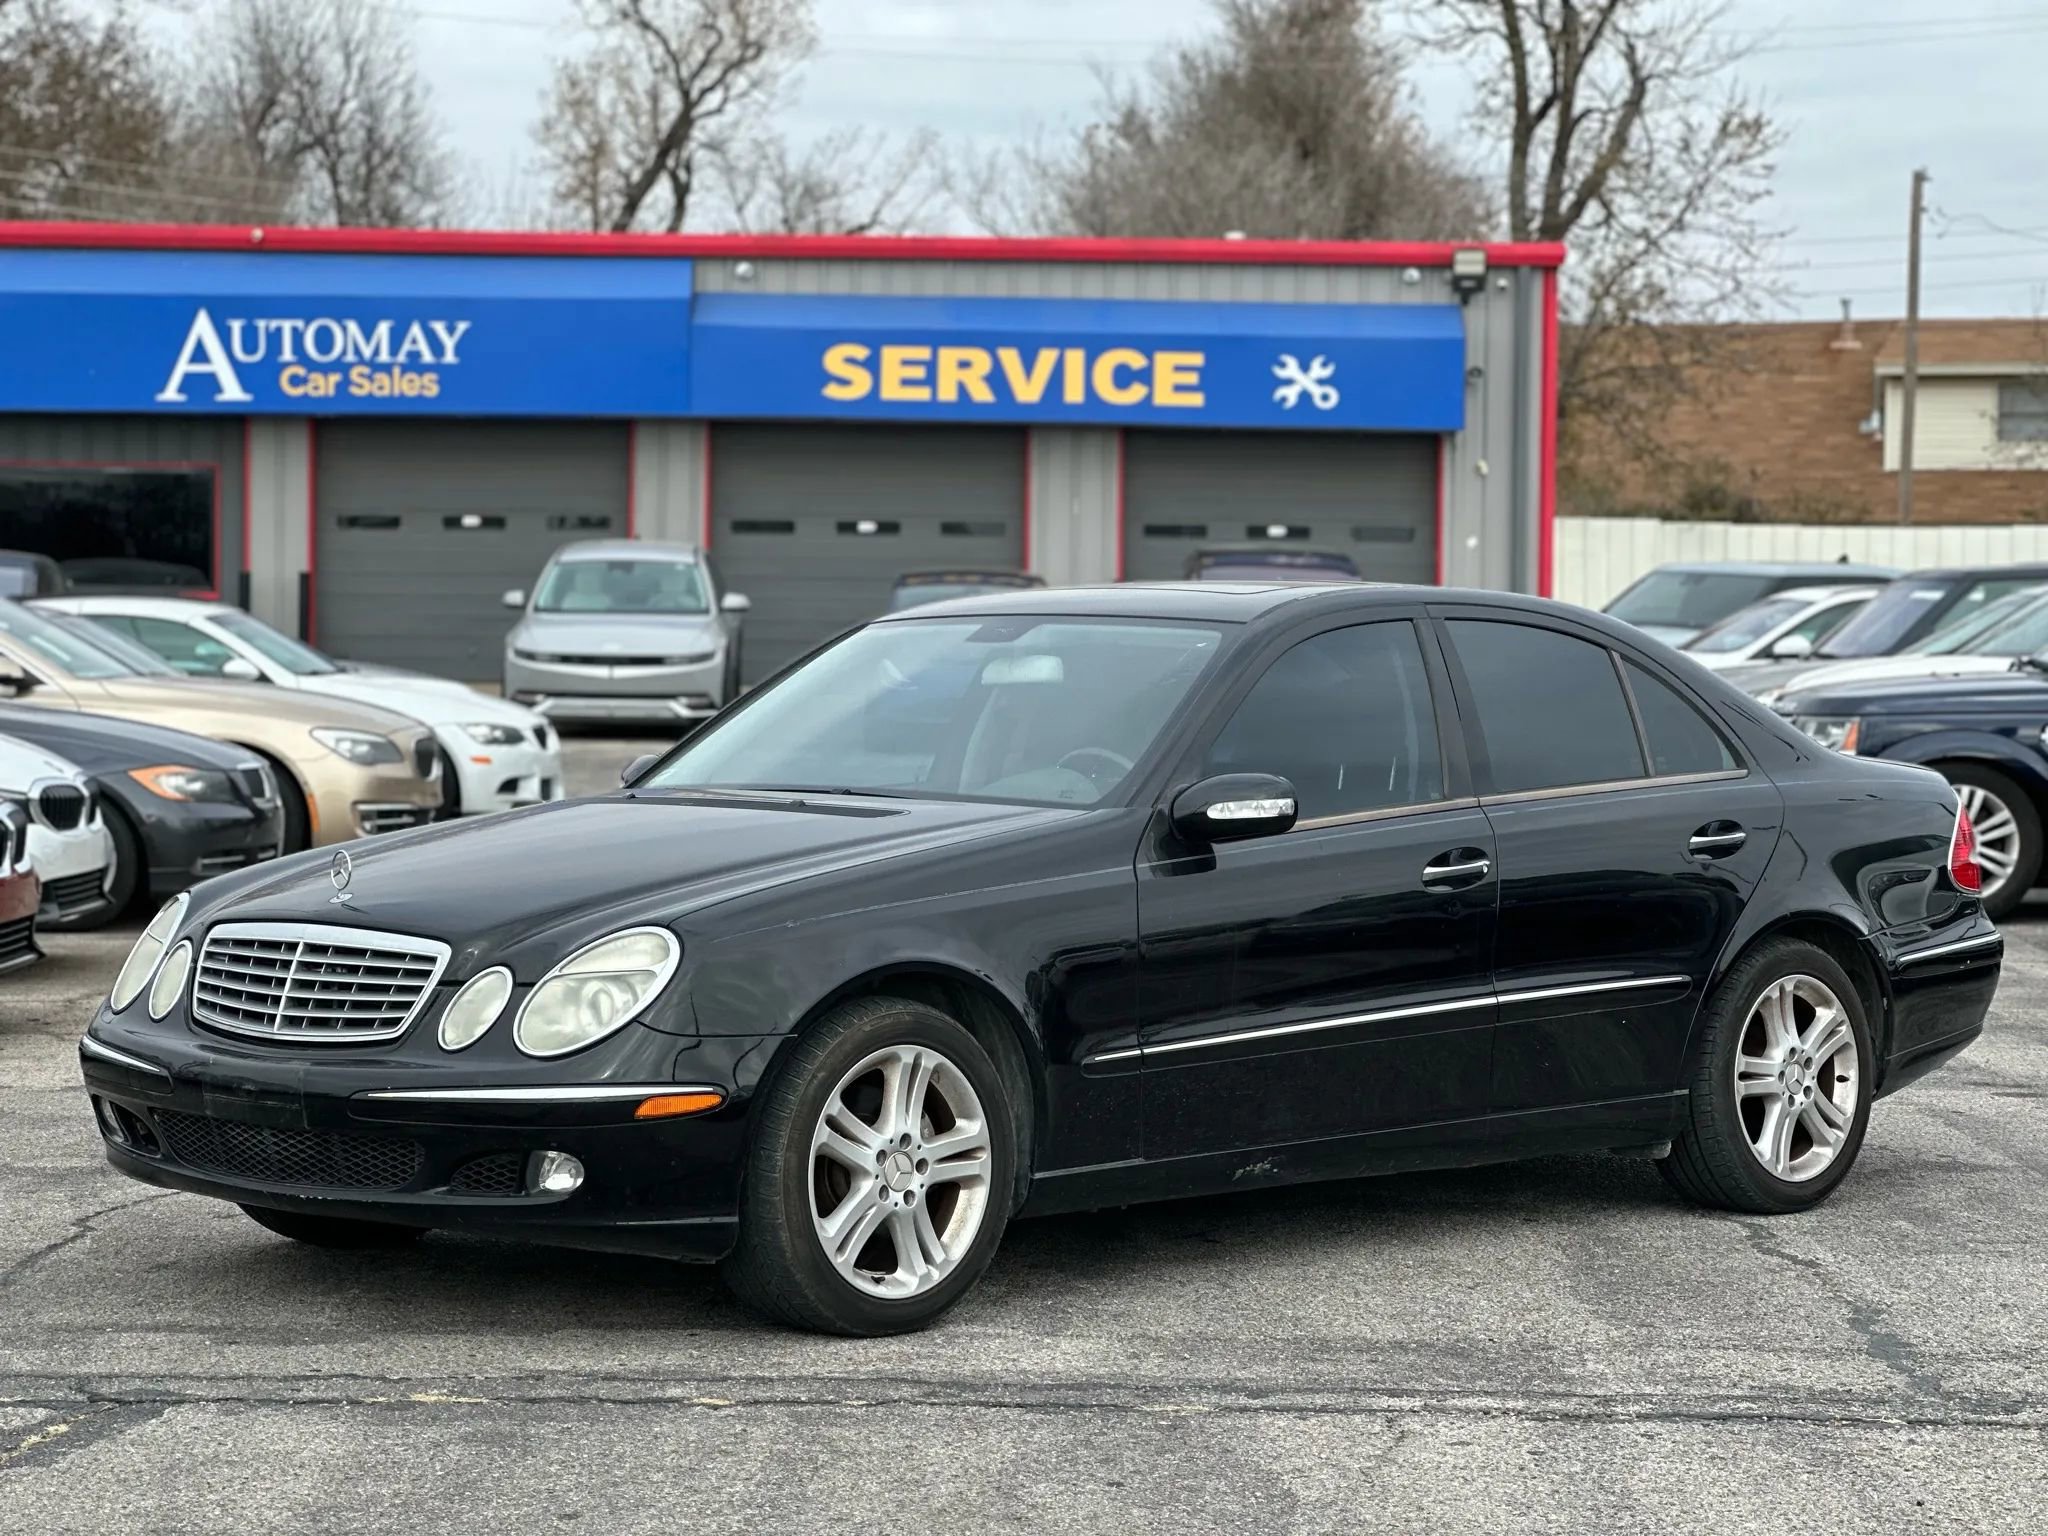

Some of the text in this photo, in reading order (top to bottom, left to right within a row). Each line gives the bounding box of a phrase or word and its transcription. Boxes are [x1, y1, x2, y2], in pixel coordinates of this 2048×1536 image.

[155, 308, 471, 402] AUTOMAY
[279, 364, 440, 397] Car Sales
[821, 342, 1206, 408] SERVICE
